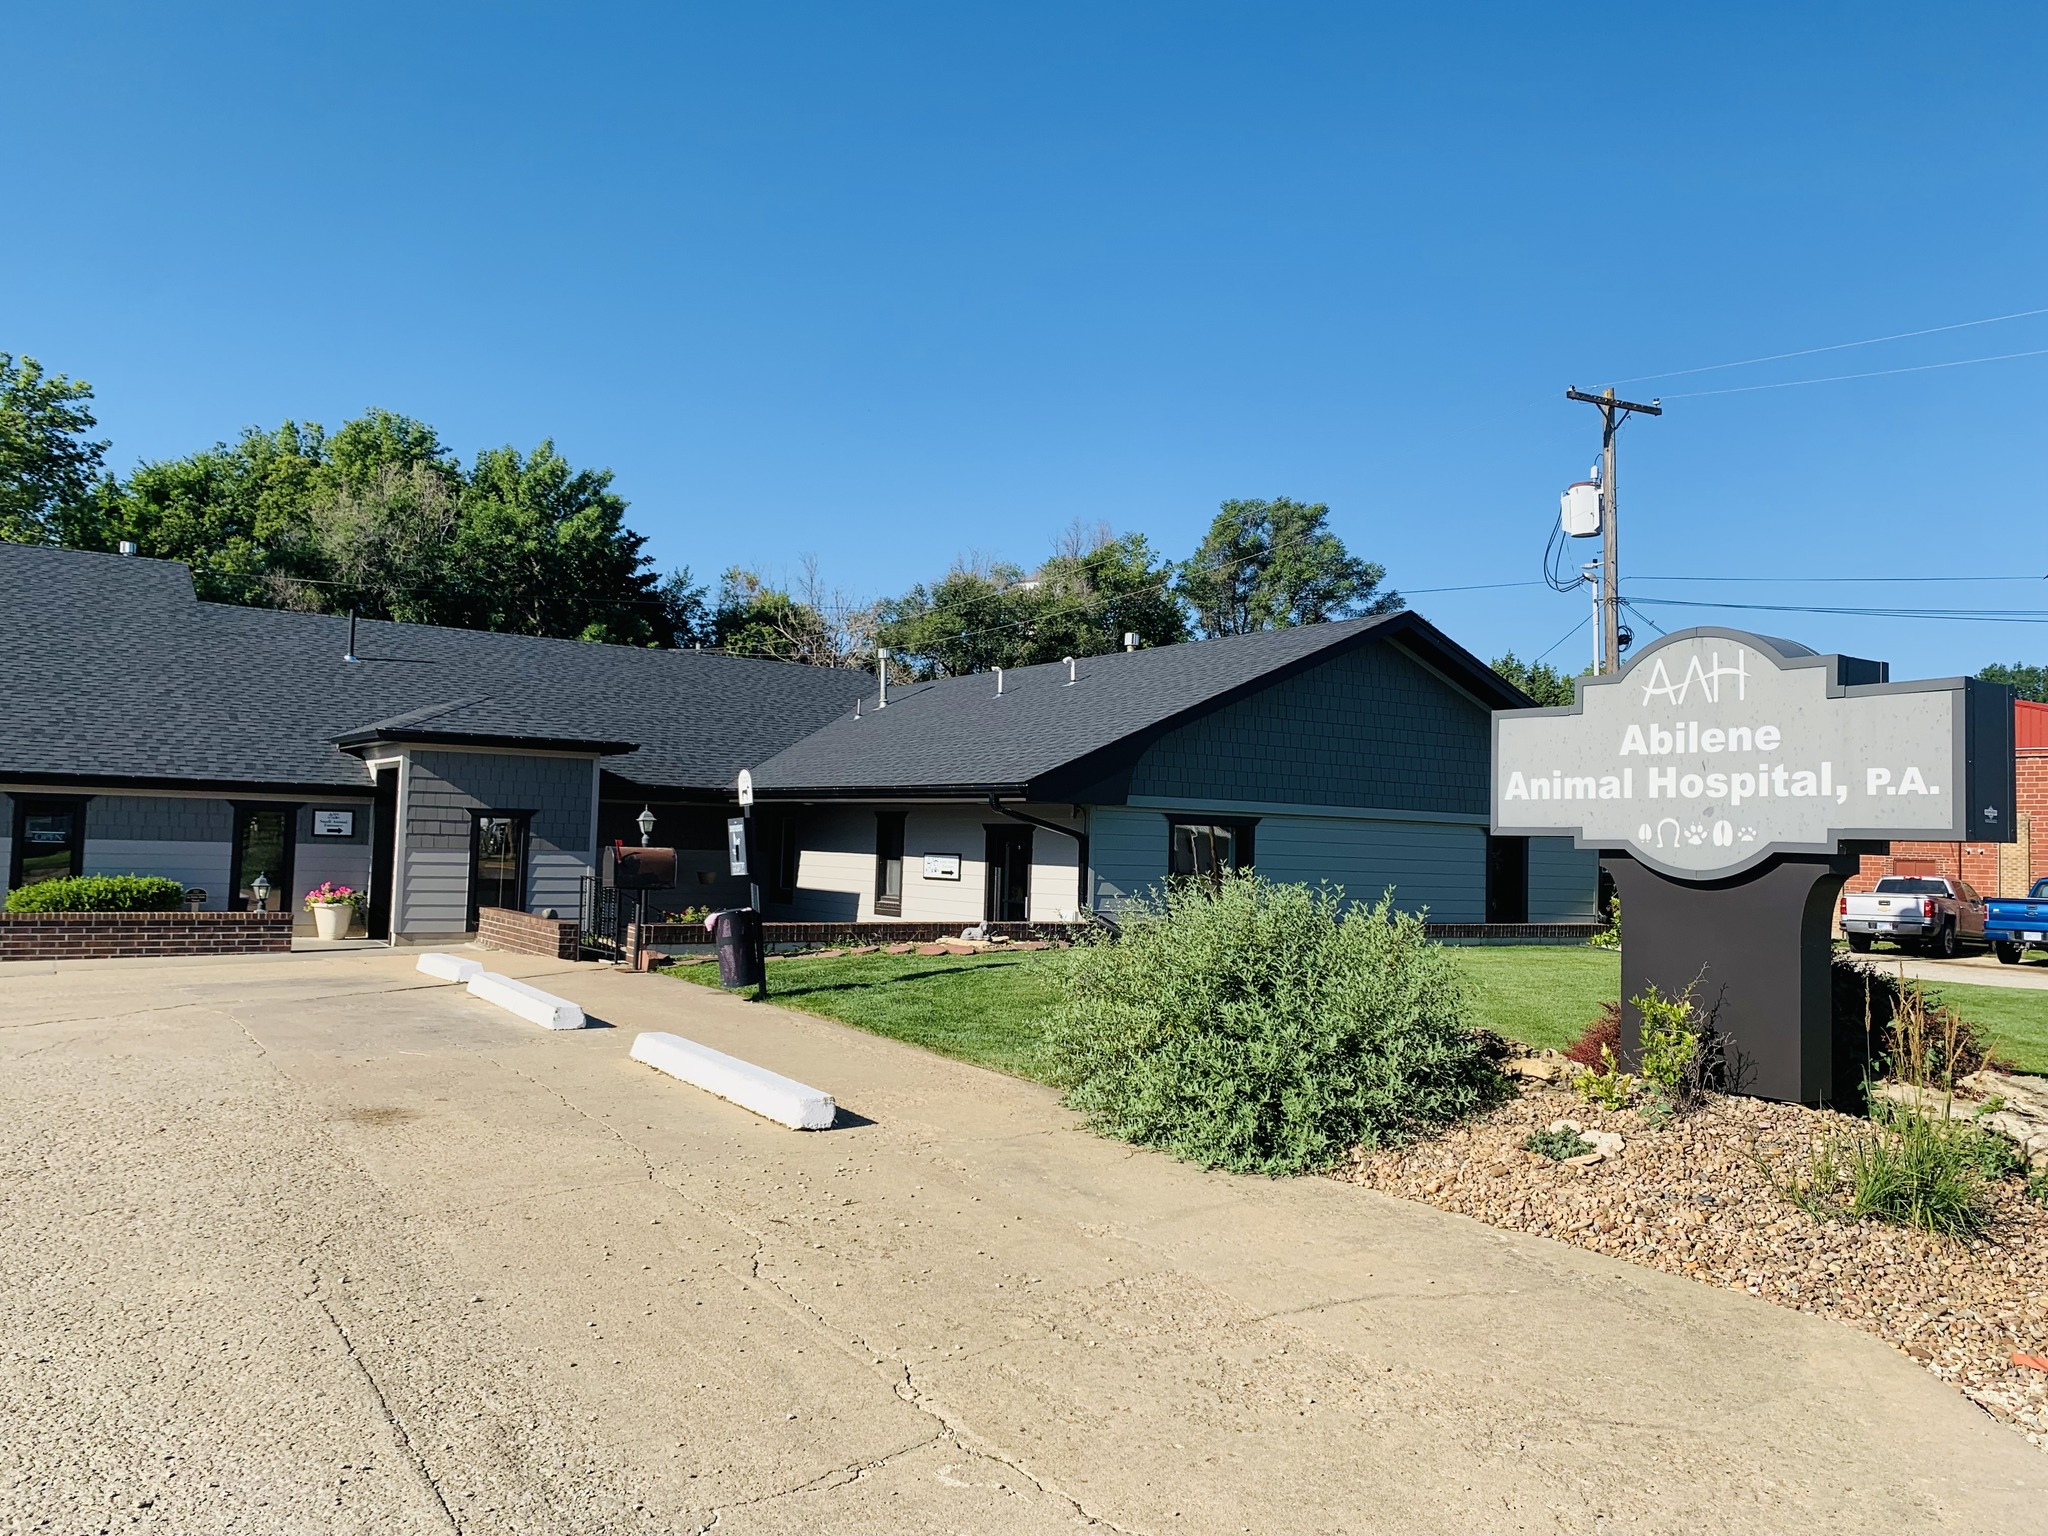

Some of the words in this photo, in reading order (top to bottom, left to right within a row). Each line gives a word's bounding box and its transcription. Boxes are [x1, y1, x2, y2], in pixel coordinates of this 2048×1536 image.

[1618, 720, 1781, 756] Abilene
[1504, 769, 1633, 801] Animal
[1648, 761, 1848, 806] Hospital,
[1866, 766, 1940, 796] P.A.
